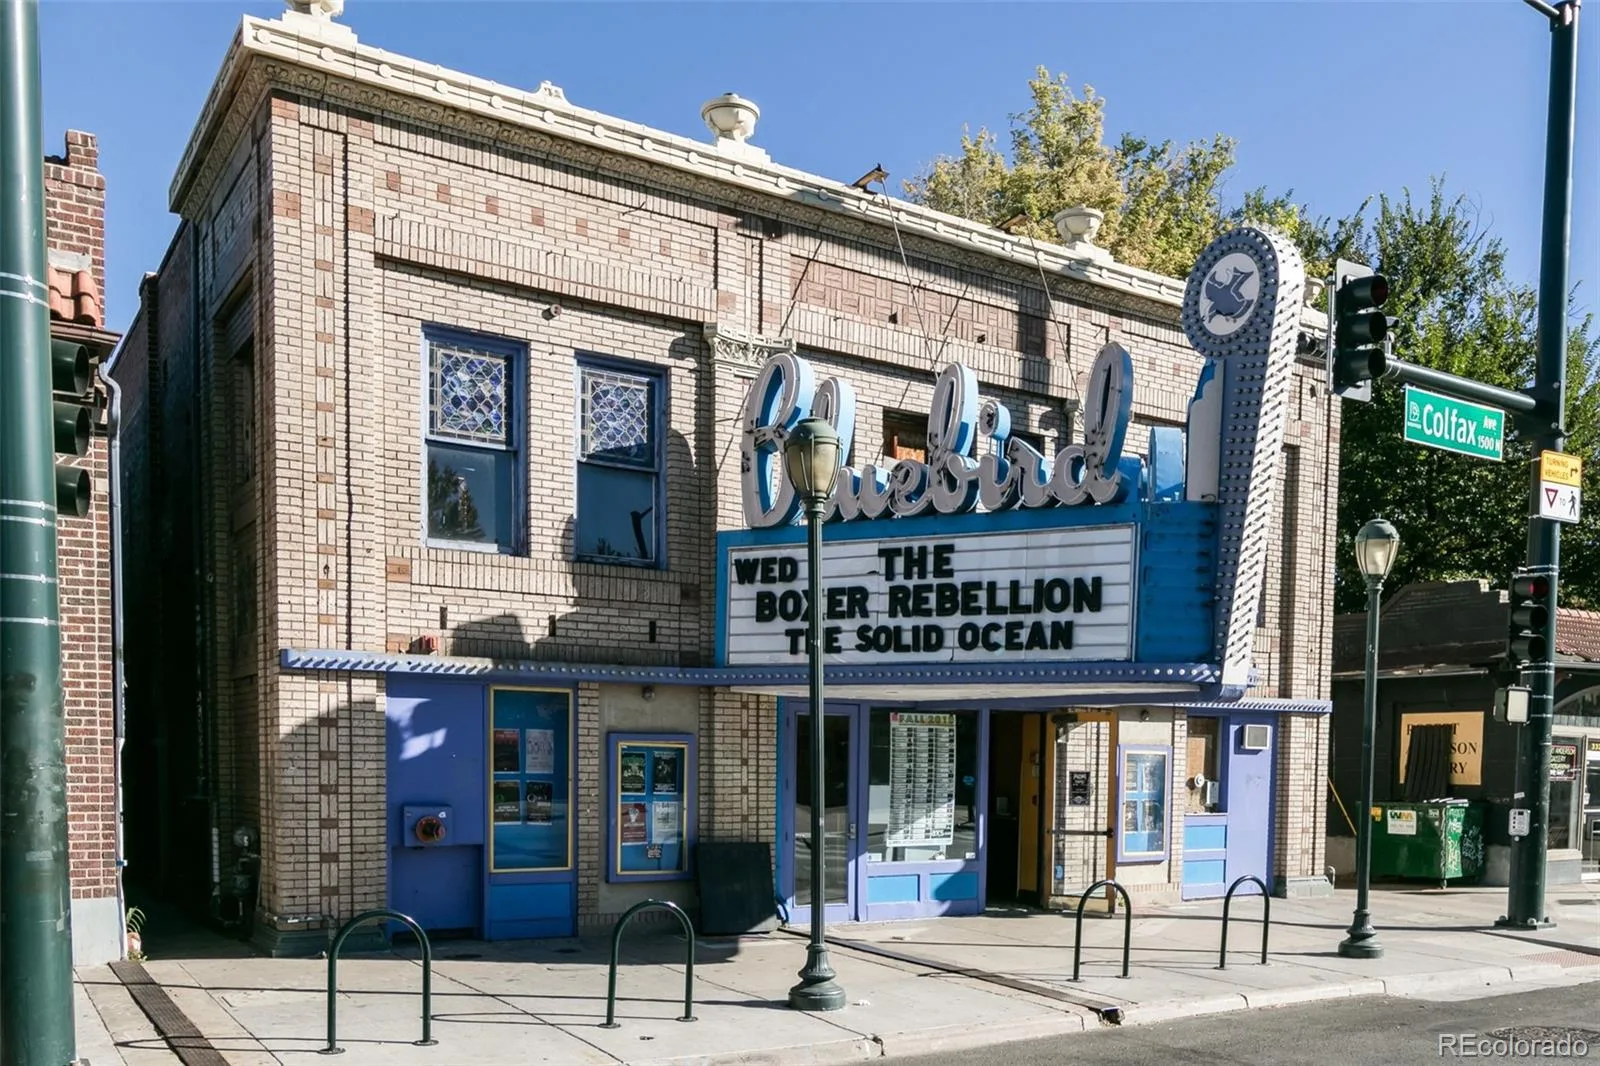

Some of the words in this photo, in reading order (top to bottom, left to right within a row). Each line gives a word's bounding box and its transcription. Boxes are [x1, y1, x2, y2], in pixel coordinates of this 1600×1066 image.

[1423, 403, 1477, 446] Colfax
[1483, 415, 1497, 430] Ave
[1478, 435, 1494, 450] 1500
[1544, 468, 1569, 480] VEHICLES
[1546, 456, 1569, 469] TURNING
[734, 556, 799, 585] WED
[877, 544, 955, 582] THE
[888, 576, 1102, 618] REBELLION
[784, 626, 842, 655] TE
[855, 624, 944, 653] SOLID
[957, 620, 1074, 652] OCEAN
